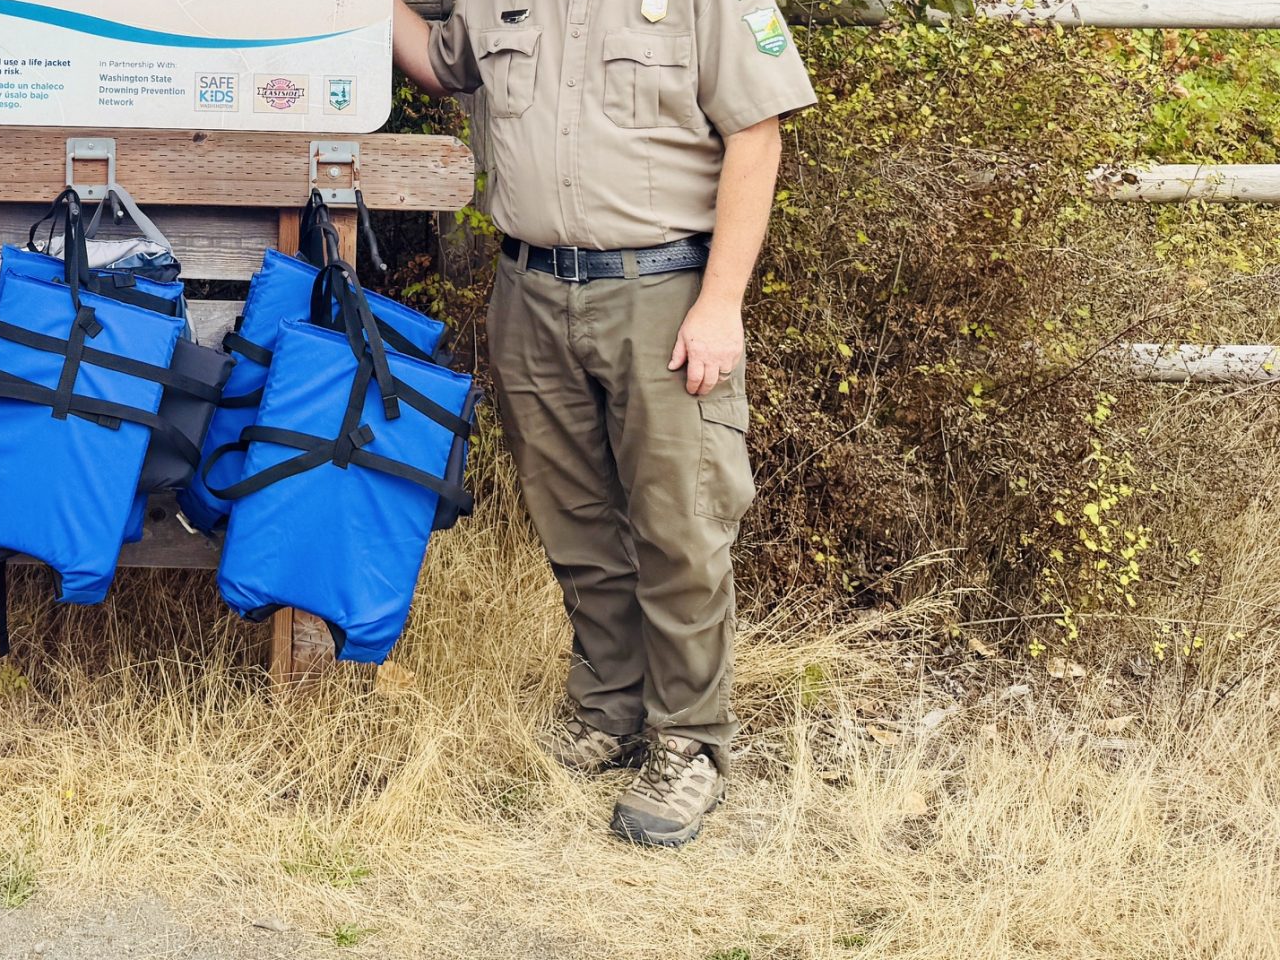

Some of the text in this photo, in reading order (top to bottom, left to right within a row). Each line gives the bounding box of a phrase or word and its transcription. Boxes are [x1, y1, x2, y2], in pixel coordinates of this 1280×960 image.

[99, 74, 148, 83] Washington
[200, 77, 234, 88] SAFE
[99, 86, 185, 95] Drowning Prevention
[30, 92, 48, 100] bajo
